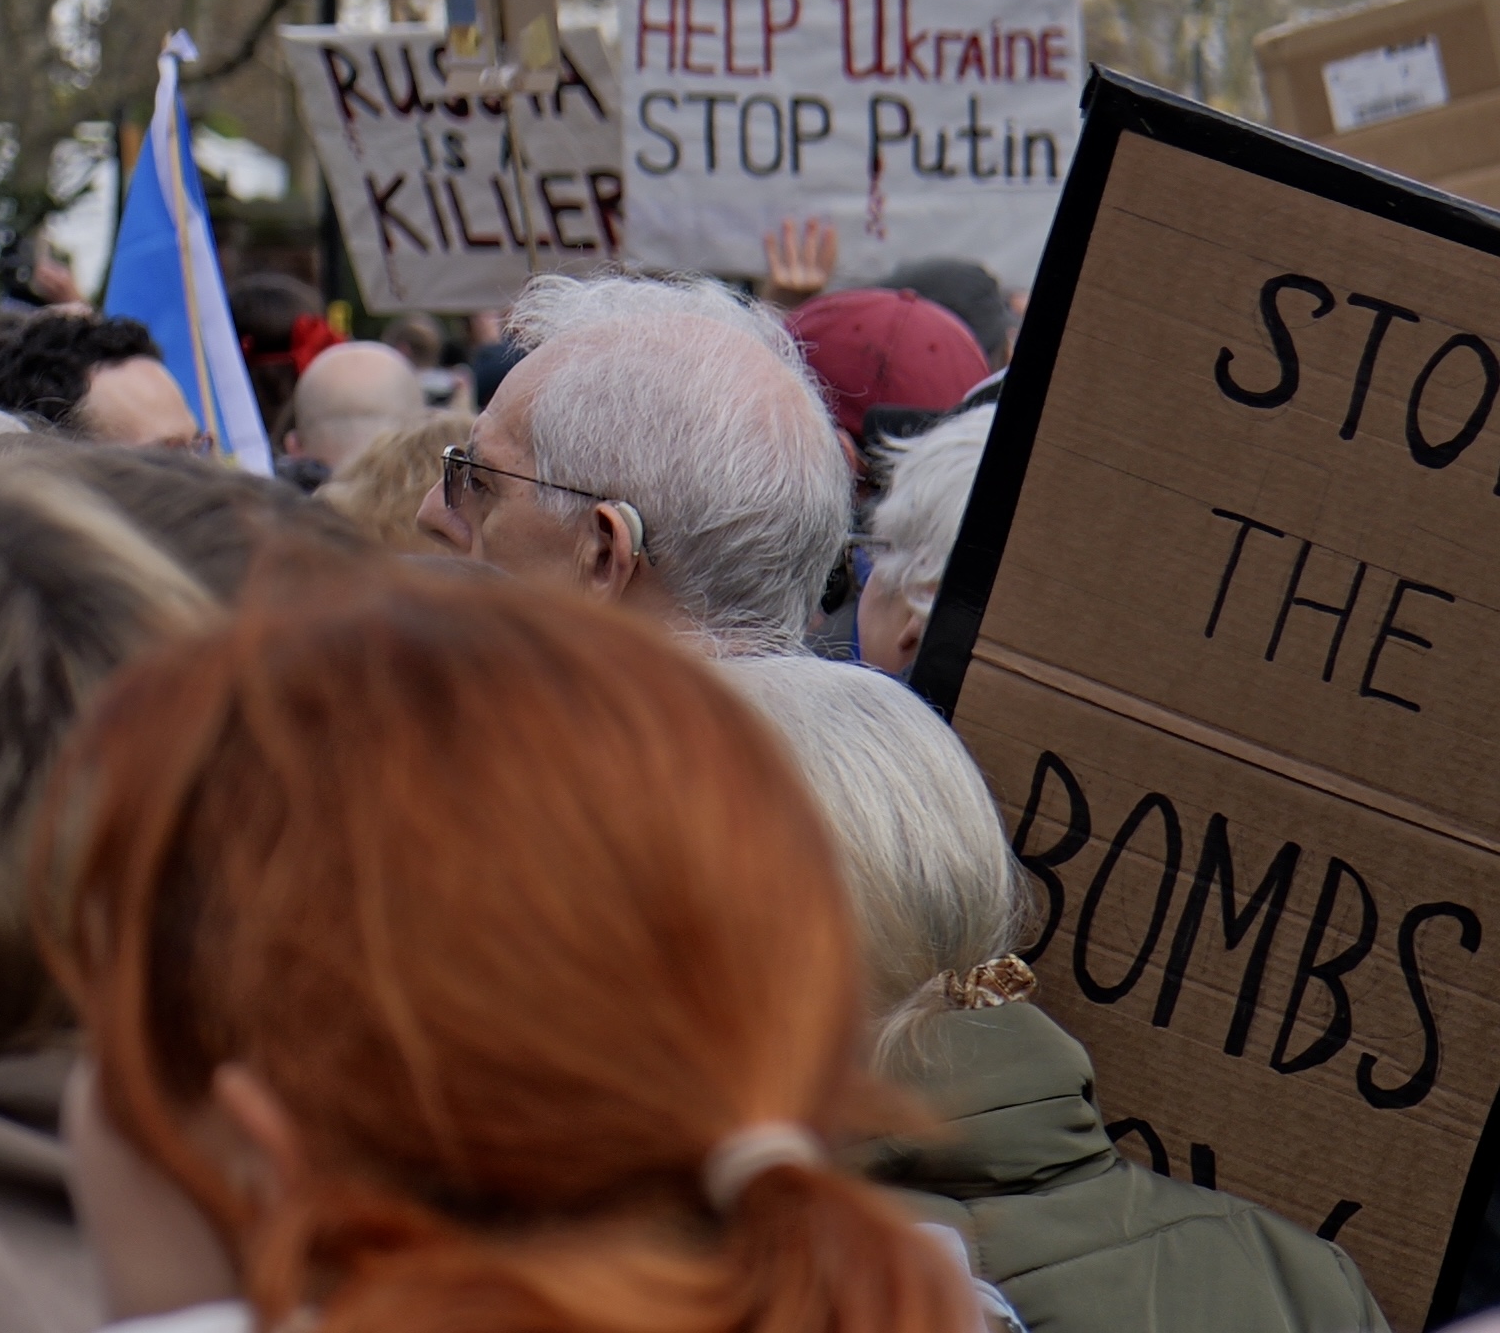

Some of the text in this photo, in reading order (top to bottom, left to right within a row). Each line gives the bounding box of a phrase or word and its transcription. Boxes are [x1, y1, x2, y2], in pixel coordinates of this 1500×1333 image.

[363, 171, 625, 256] KILLER
[634, 89, 1060, 185] STOP Putin
[1214, 273, 1500, 497] STO
[1205, 507, 1457, 713] THE
[1010, 749, 1483, 1111] BOMBS
